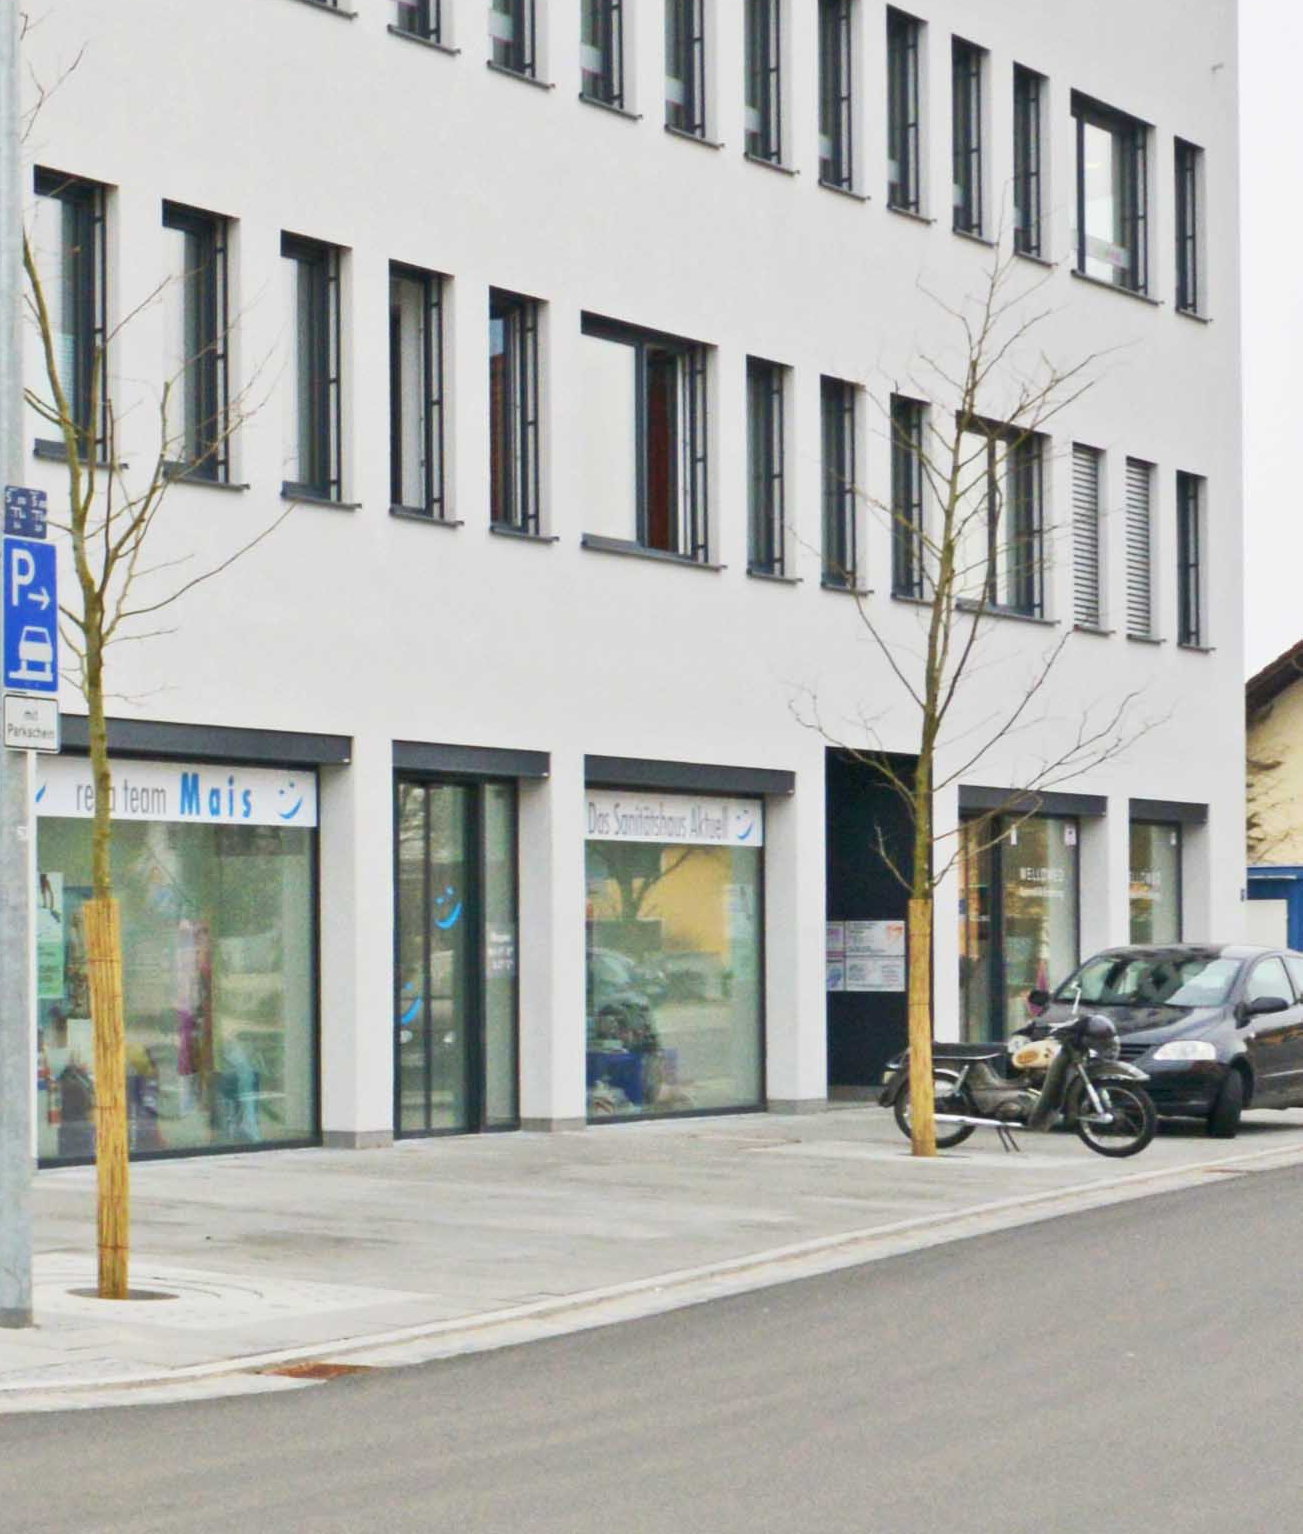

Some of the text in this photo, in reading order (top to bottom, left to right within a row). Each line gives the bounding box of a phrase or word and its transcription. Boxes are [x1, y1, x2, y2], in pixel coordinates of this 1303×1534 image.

[11, 548, 35, 607] P
[75, 772, 252, 818] rea team Mais
[588, 801, 610, 835] Das
